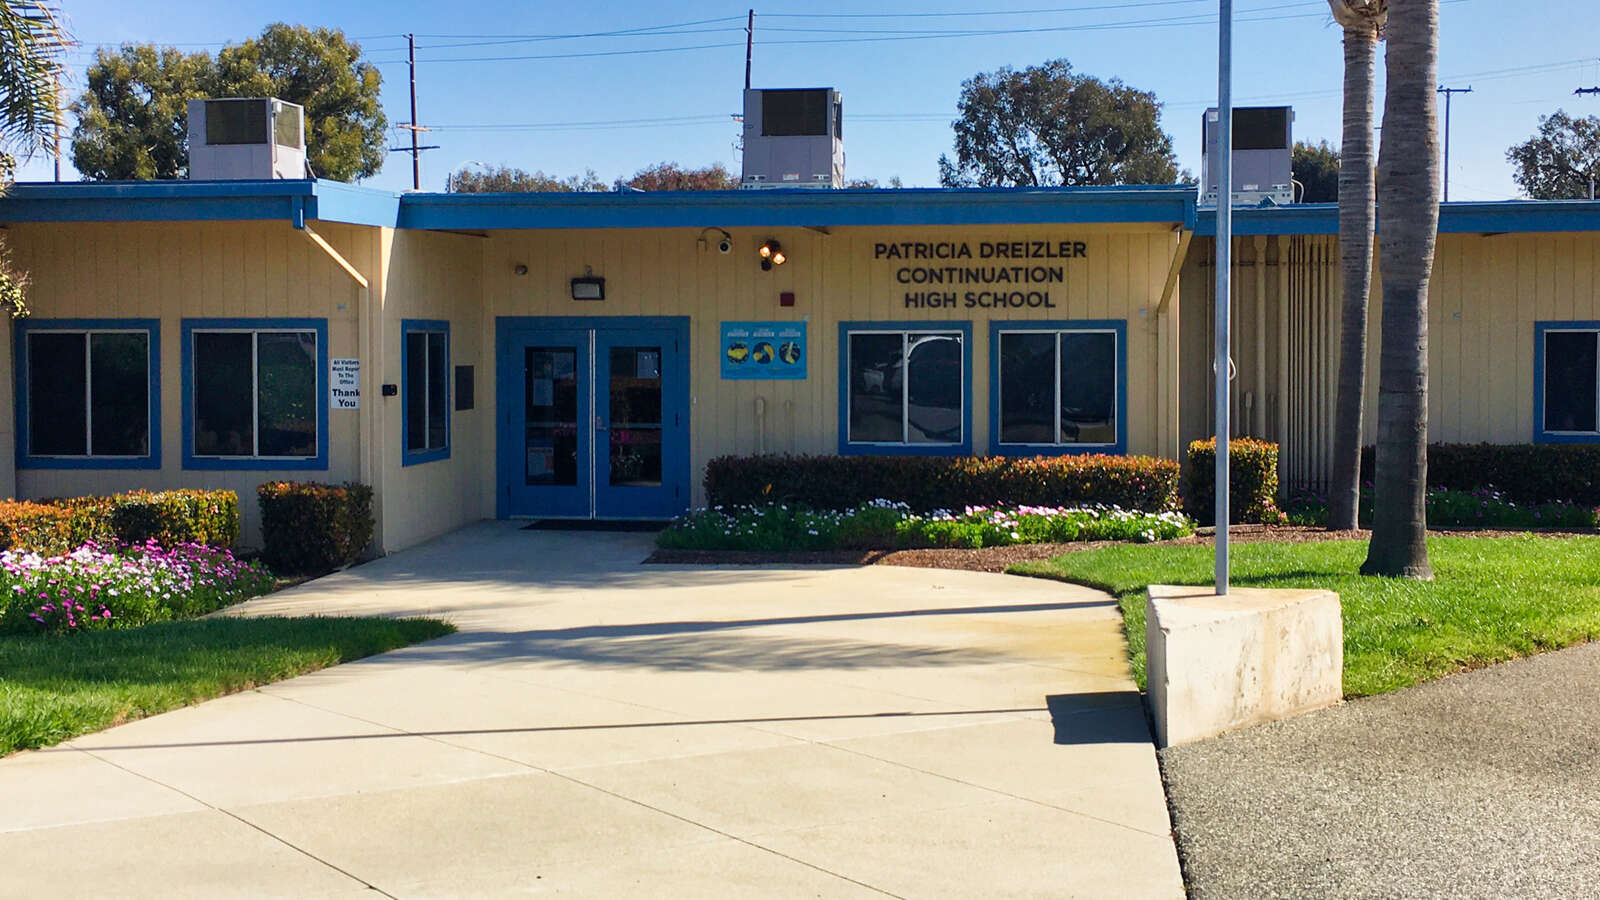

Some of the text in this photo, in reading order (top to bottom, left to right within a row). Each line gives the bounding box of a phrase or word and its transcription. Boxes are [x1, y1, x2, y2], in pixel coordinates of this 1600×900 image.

[875, 241, 1087, 259] PATRICIA DREIZLER
[897, 266, 1063, 284] CONTINUATION
[905, 291, 1056, 308] HIGH SCHOOL
[332, 389, 360, 397] Thank
[338, 399, 356, 407] You
